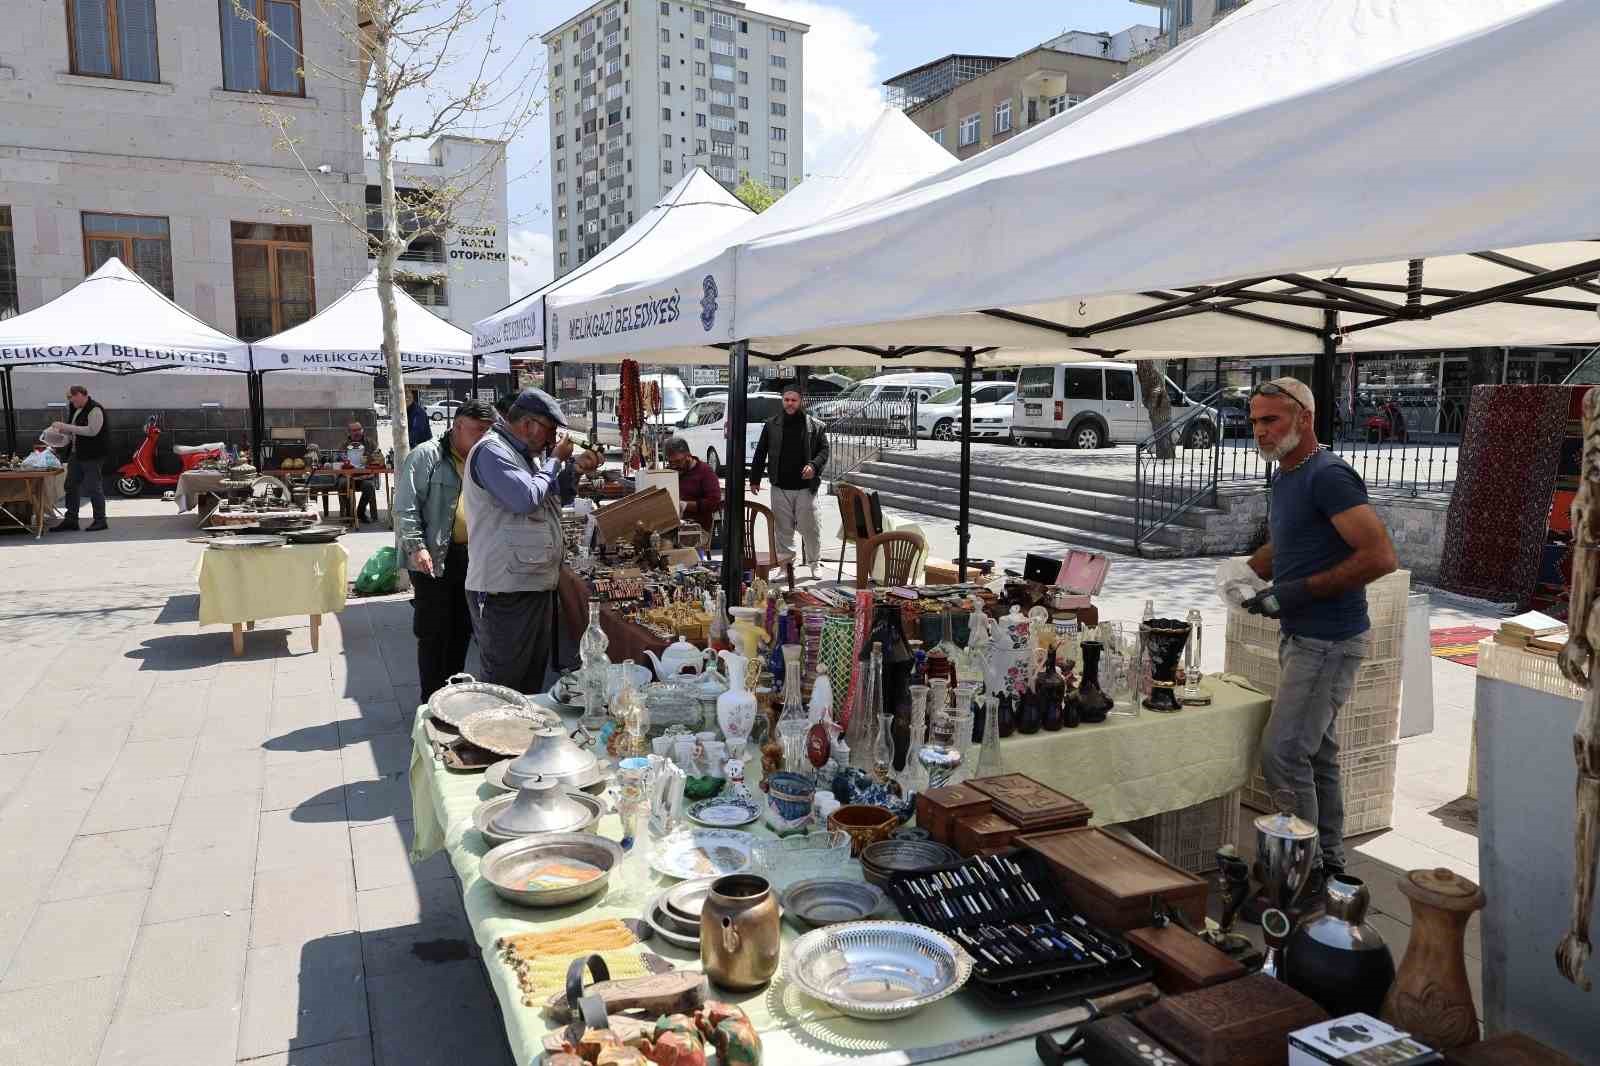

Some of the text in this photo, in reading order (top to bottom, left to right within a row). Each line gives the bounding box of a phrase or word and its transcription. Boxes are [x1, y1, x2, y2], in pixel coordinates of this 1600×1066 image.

[569, 287, 680, 341] MELİKGAZİ BELEDİYESİ
[0, 342, 215, 364] ELİKGAZİ BELEDİYESİ
[303, 351, 465, 366] MELİKGAZİ ELEDİYESİ
